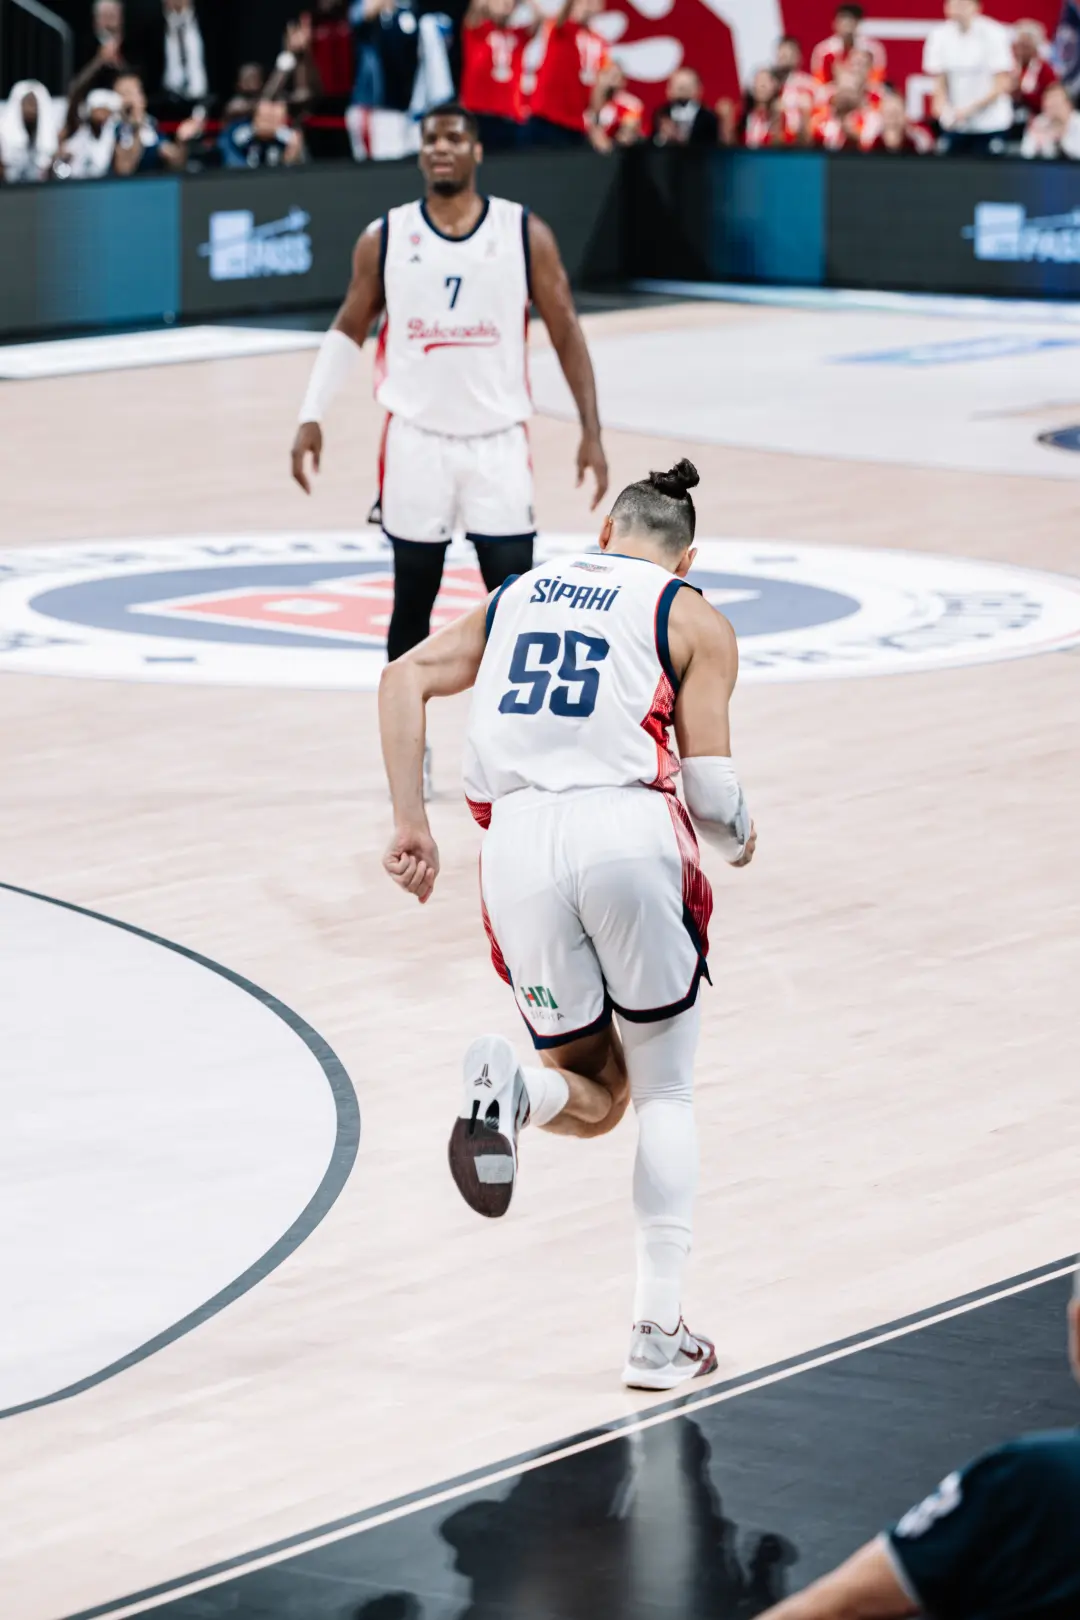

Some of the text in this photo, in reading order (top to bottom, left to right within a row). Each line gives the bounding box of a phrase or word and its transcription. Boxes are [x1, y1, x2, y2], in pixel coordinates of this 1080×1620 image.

[445, 276, 462, 310] 7
[498, 630, 611, 717] 55
[640, 1325, 652, 1334] 33
